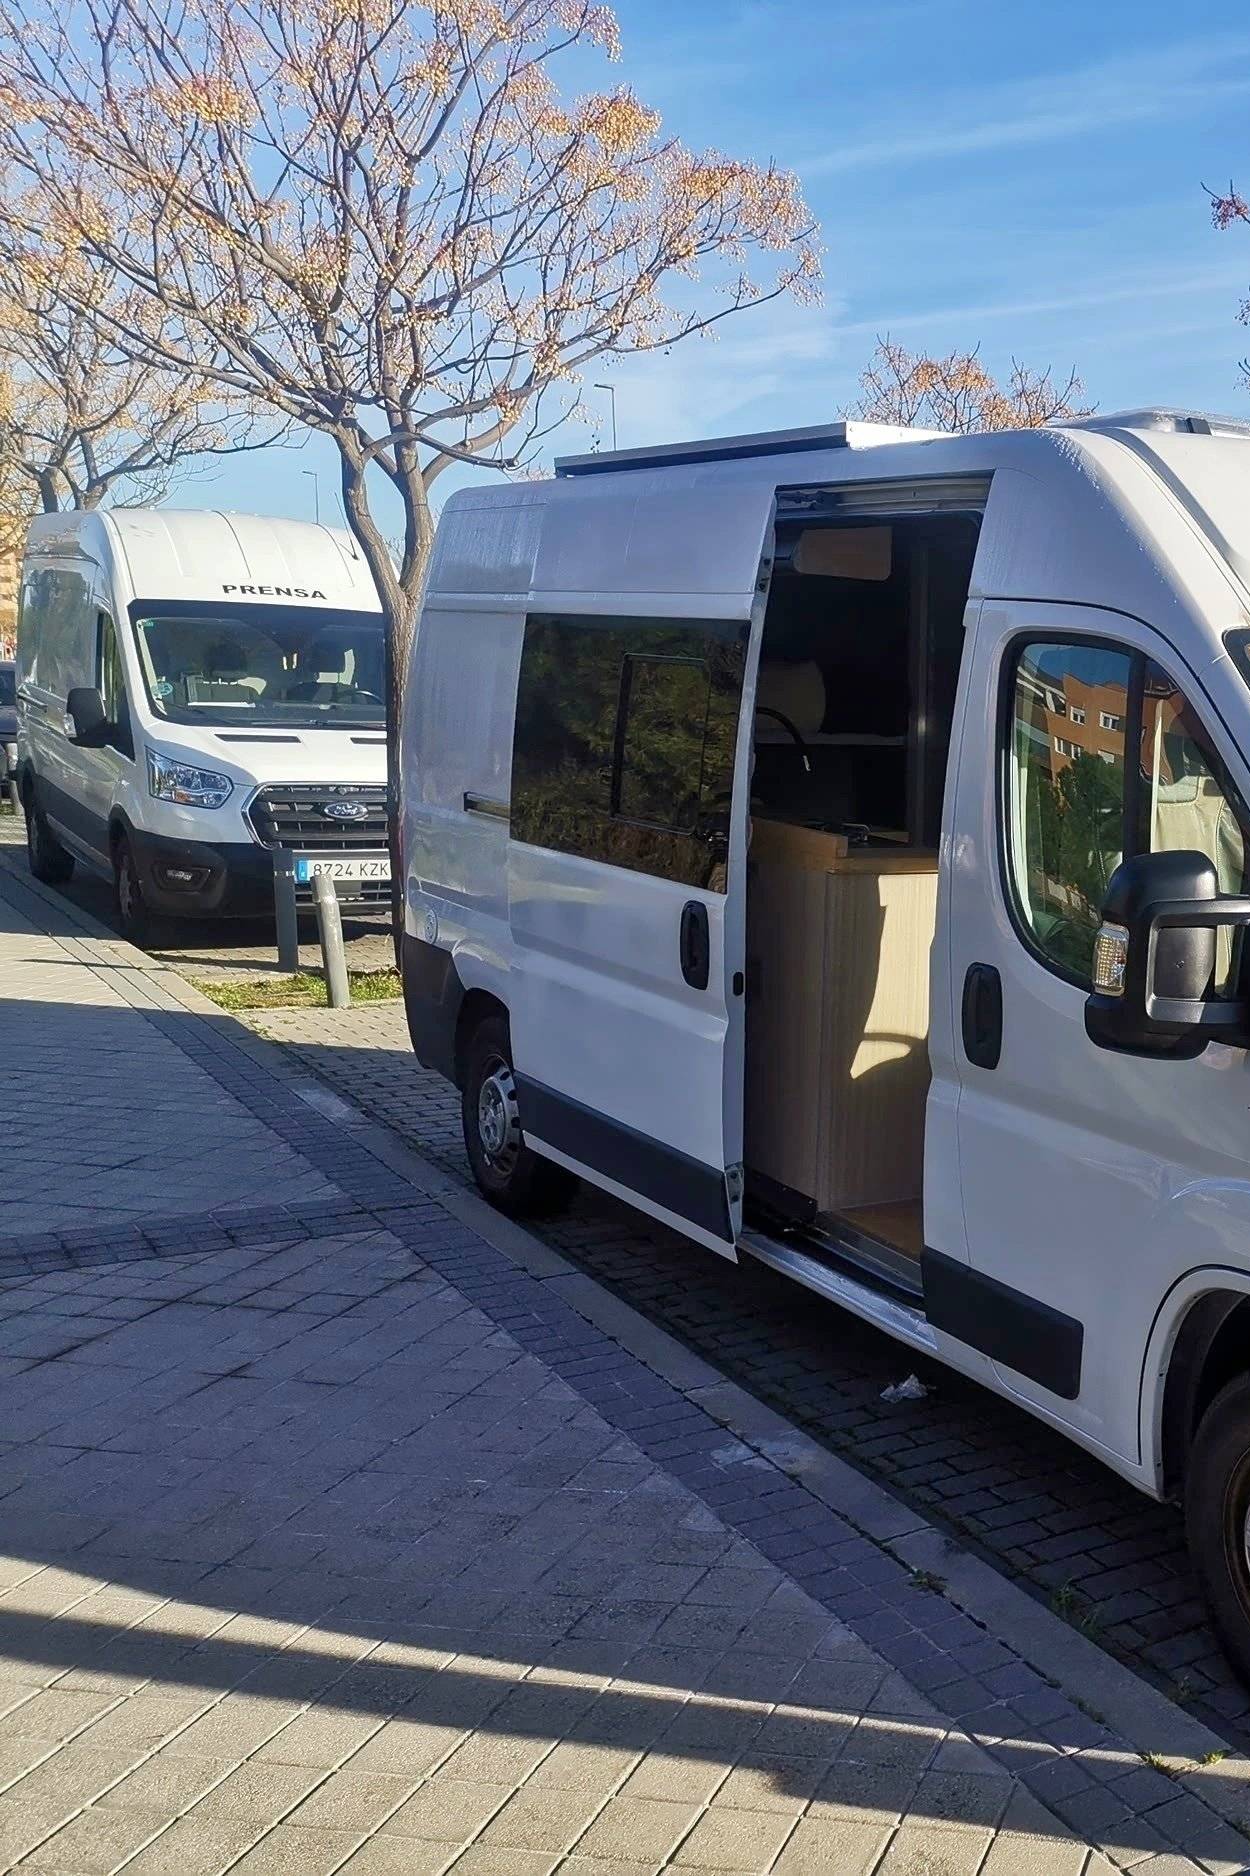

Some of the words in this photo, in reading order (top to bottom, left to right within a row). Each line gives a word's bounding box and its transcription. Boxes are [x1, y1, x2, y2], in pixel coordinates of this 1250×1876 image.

[222, 585, 328, 600] PRENSA
[313, 863, 353, 877] 8724
[360, 863, 389, 877] KZK
